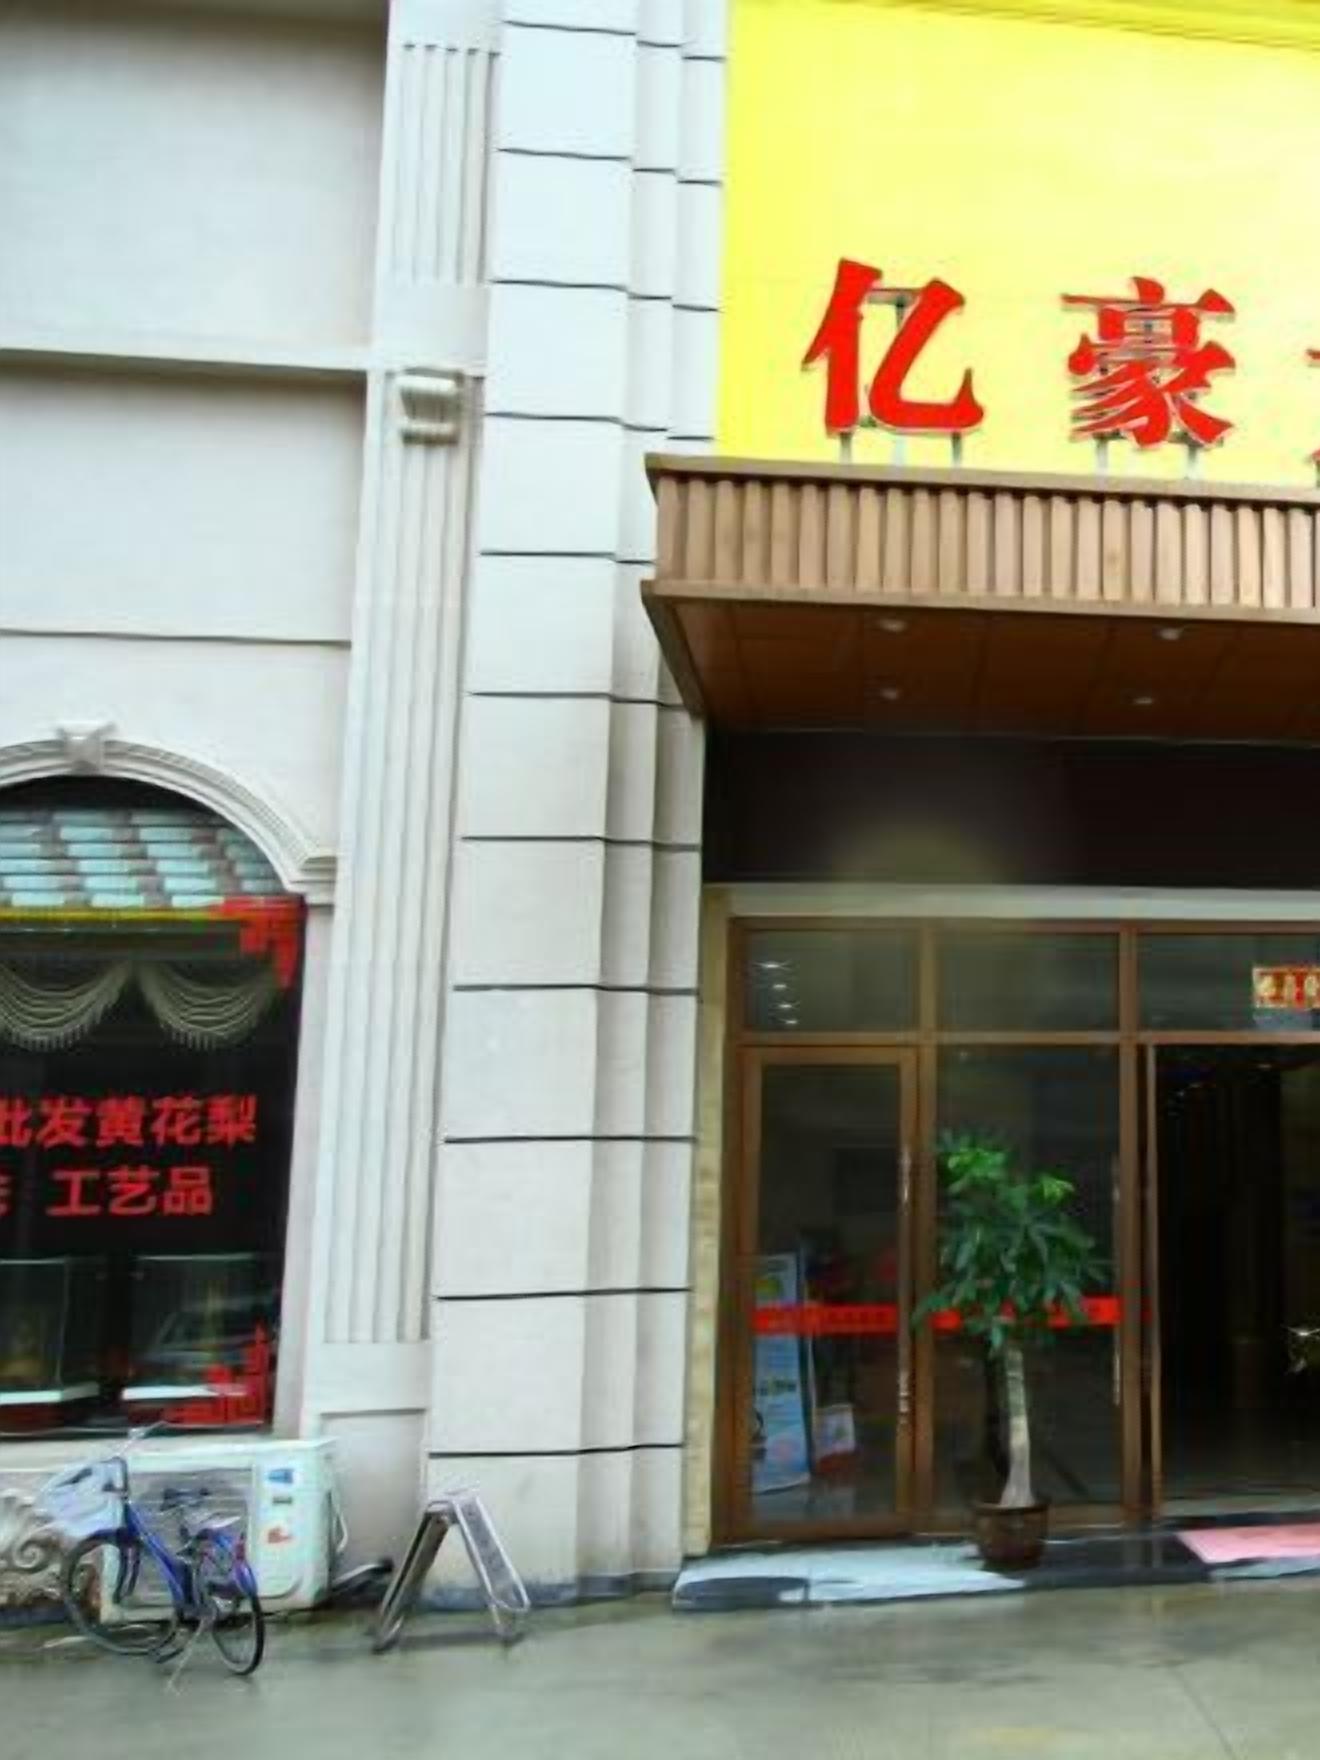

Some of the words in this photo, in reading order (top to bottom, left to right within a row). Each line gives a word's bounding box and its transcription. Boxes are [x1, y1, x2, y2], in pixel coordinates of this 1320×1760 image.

[0, 1094, 258, 1148] 批发黄花梨
[46, 1165, 214, 1216] 工艺品
